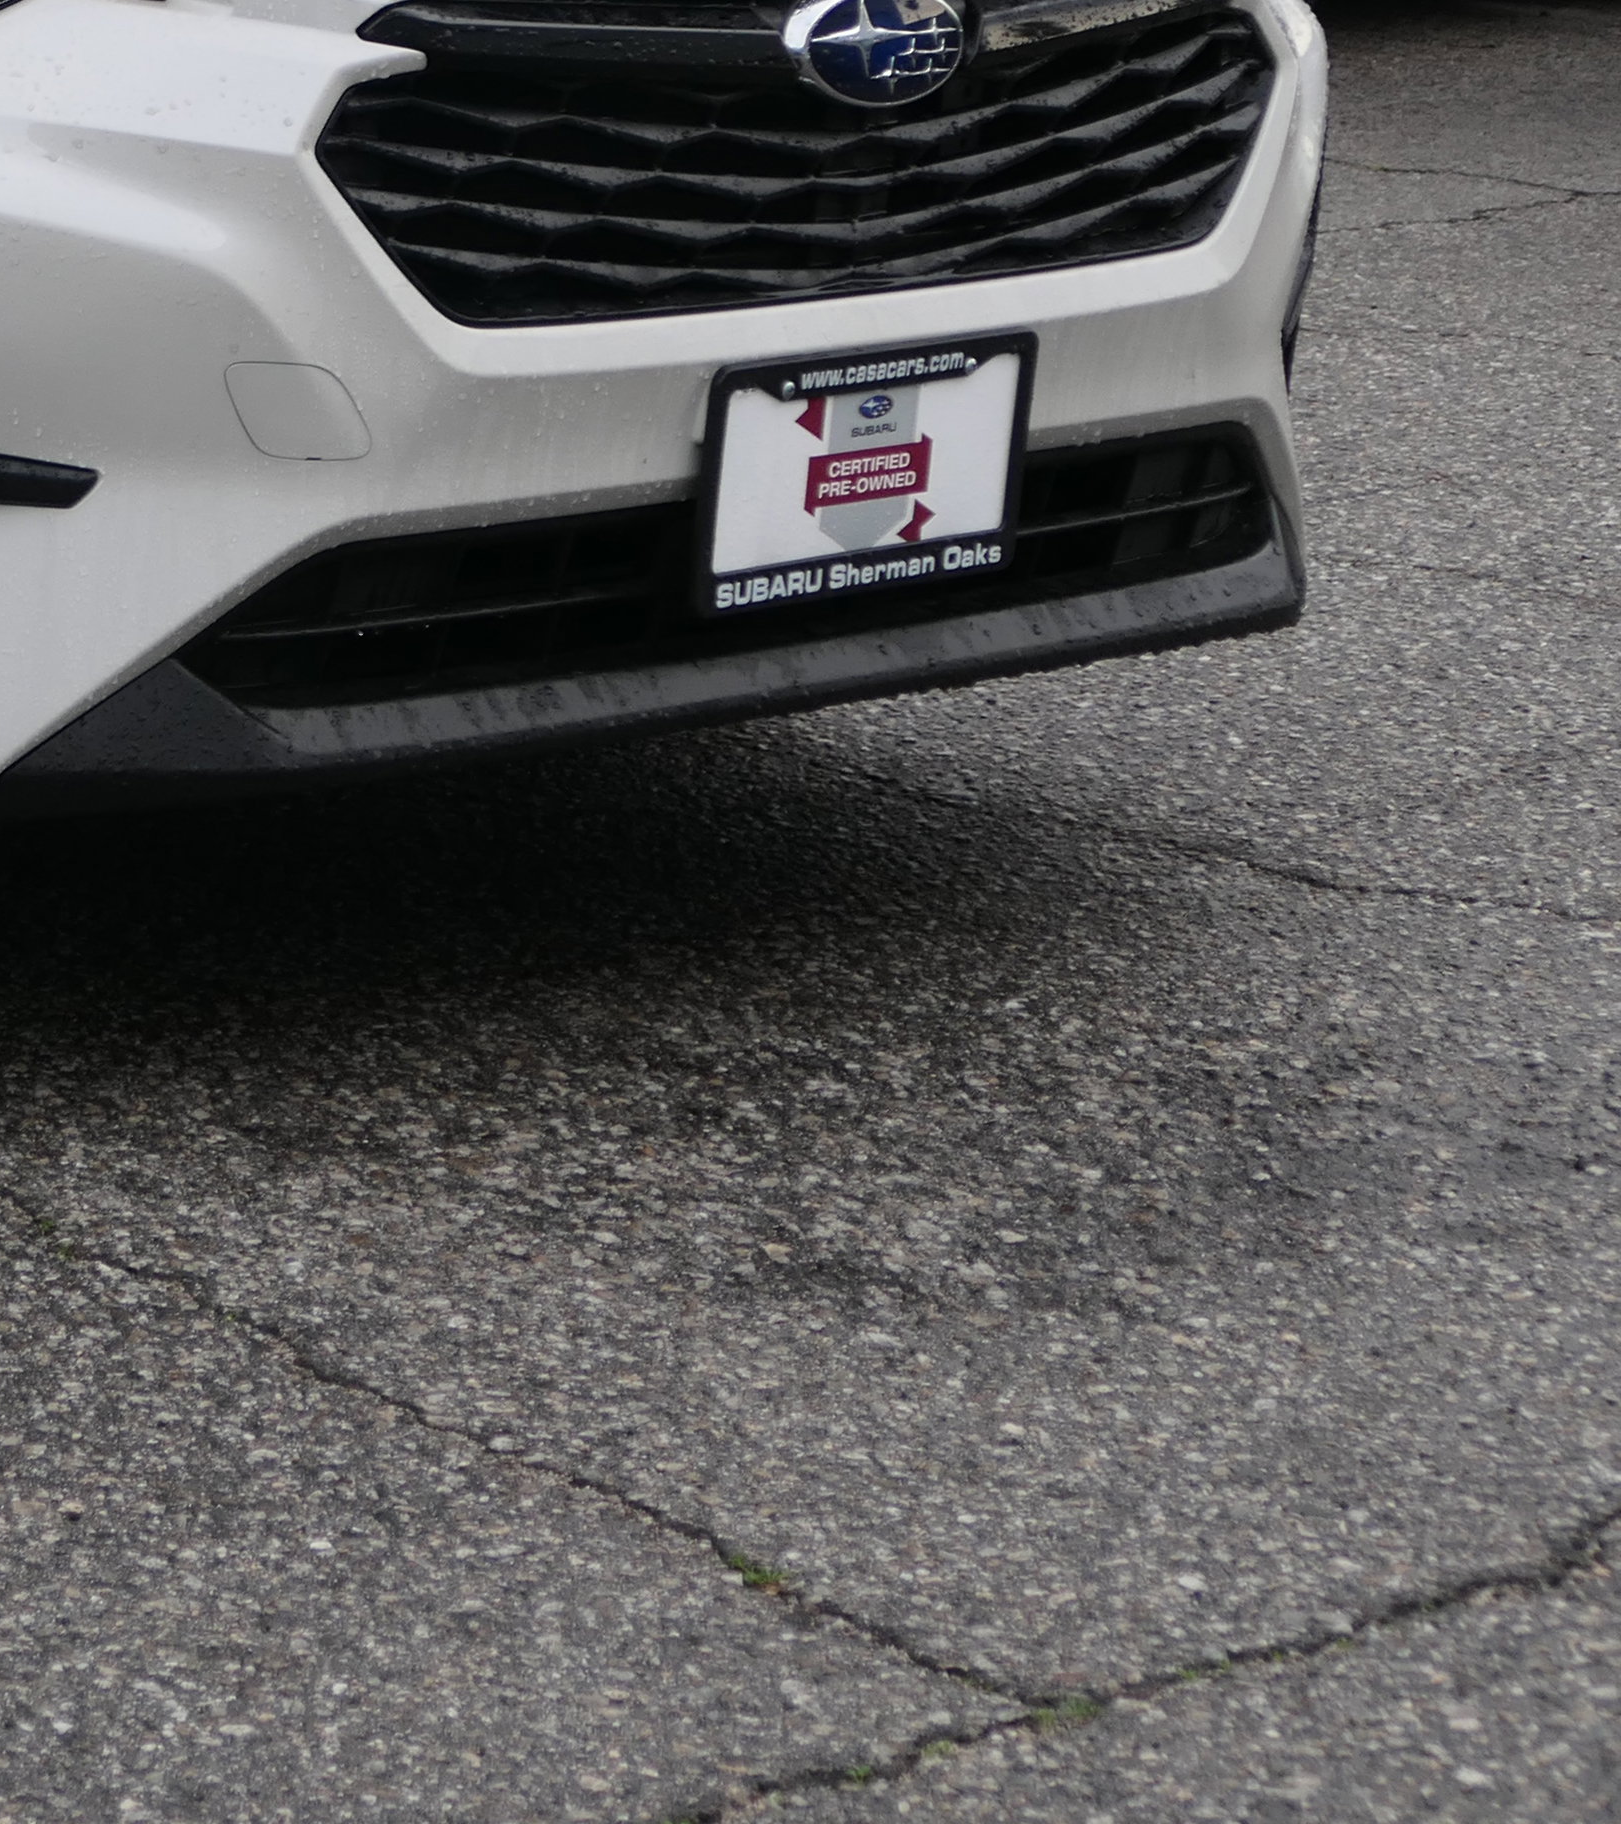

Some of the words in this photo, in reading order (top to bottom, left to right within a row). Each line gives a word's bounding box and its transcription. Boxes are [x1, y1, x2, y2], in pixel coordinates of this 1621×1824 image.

[801, 350, 964, 391] www.casacars.com
[851, 422, 898, 439] SUBARU
[828, 452, 911, 479] CERTIFIED
[817, 471, 917, 500] PRE-OWNED
[715, 568, 823, 610] SUBARU
[829, 554, 935, 591] Sherman
[942, 542, 1003, 572] Oaks
